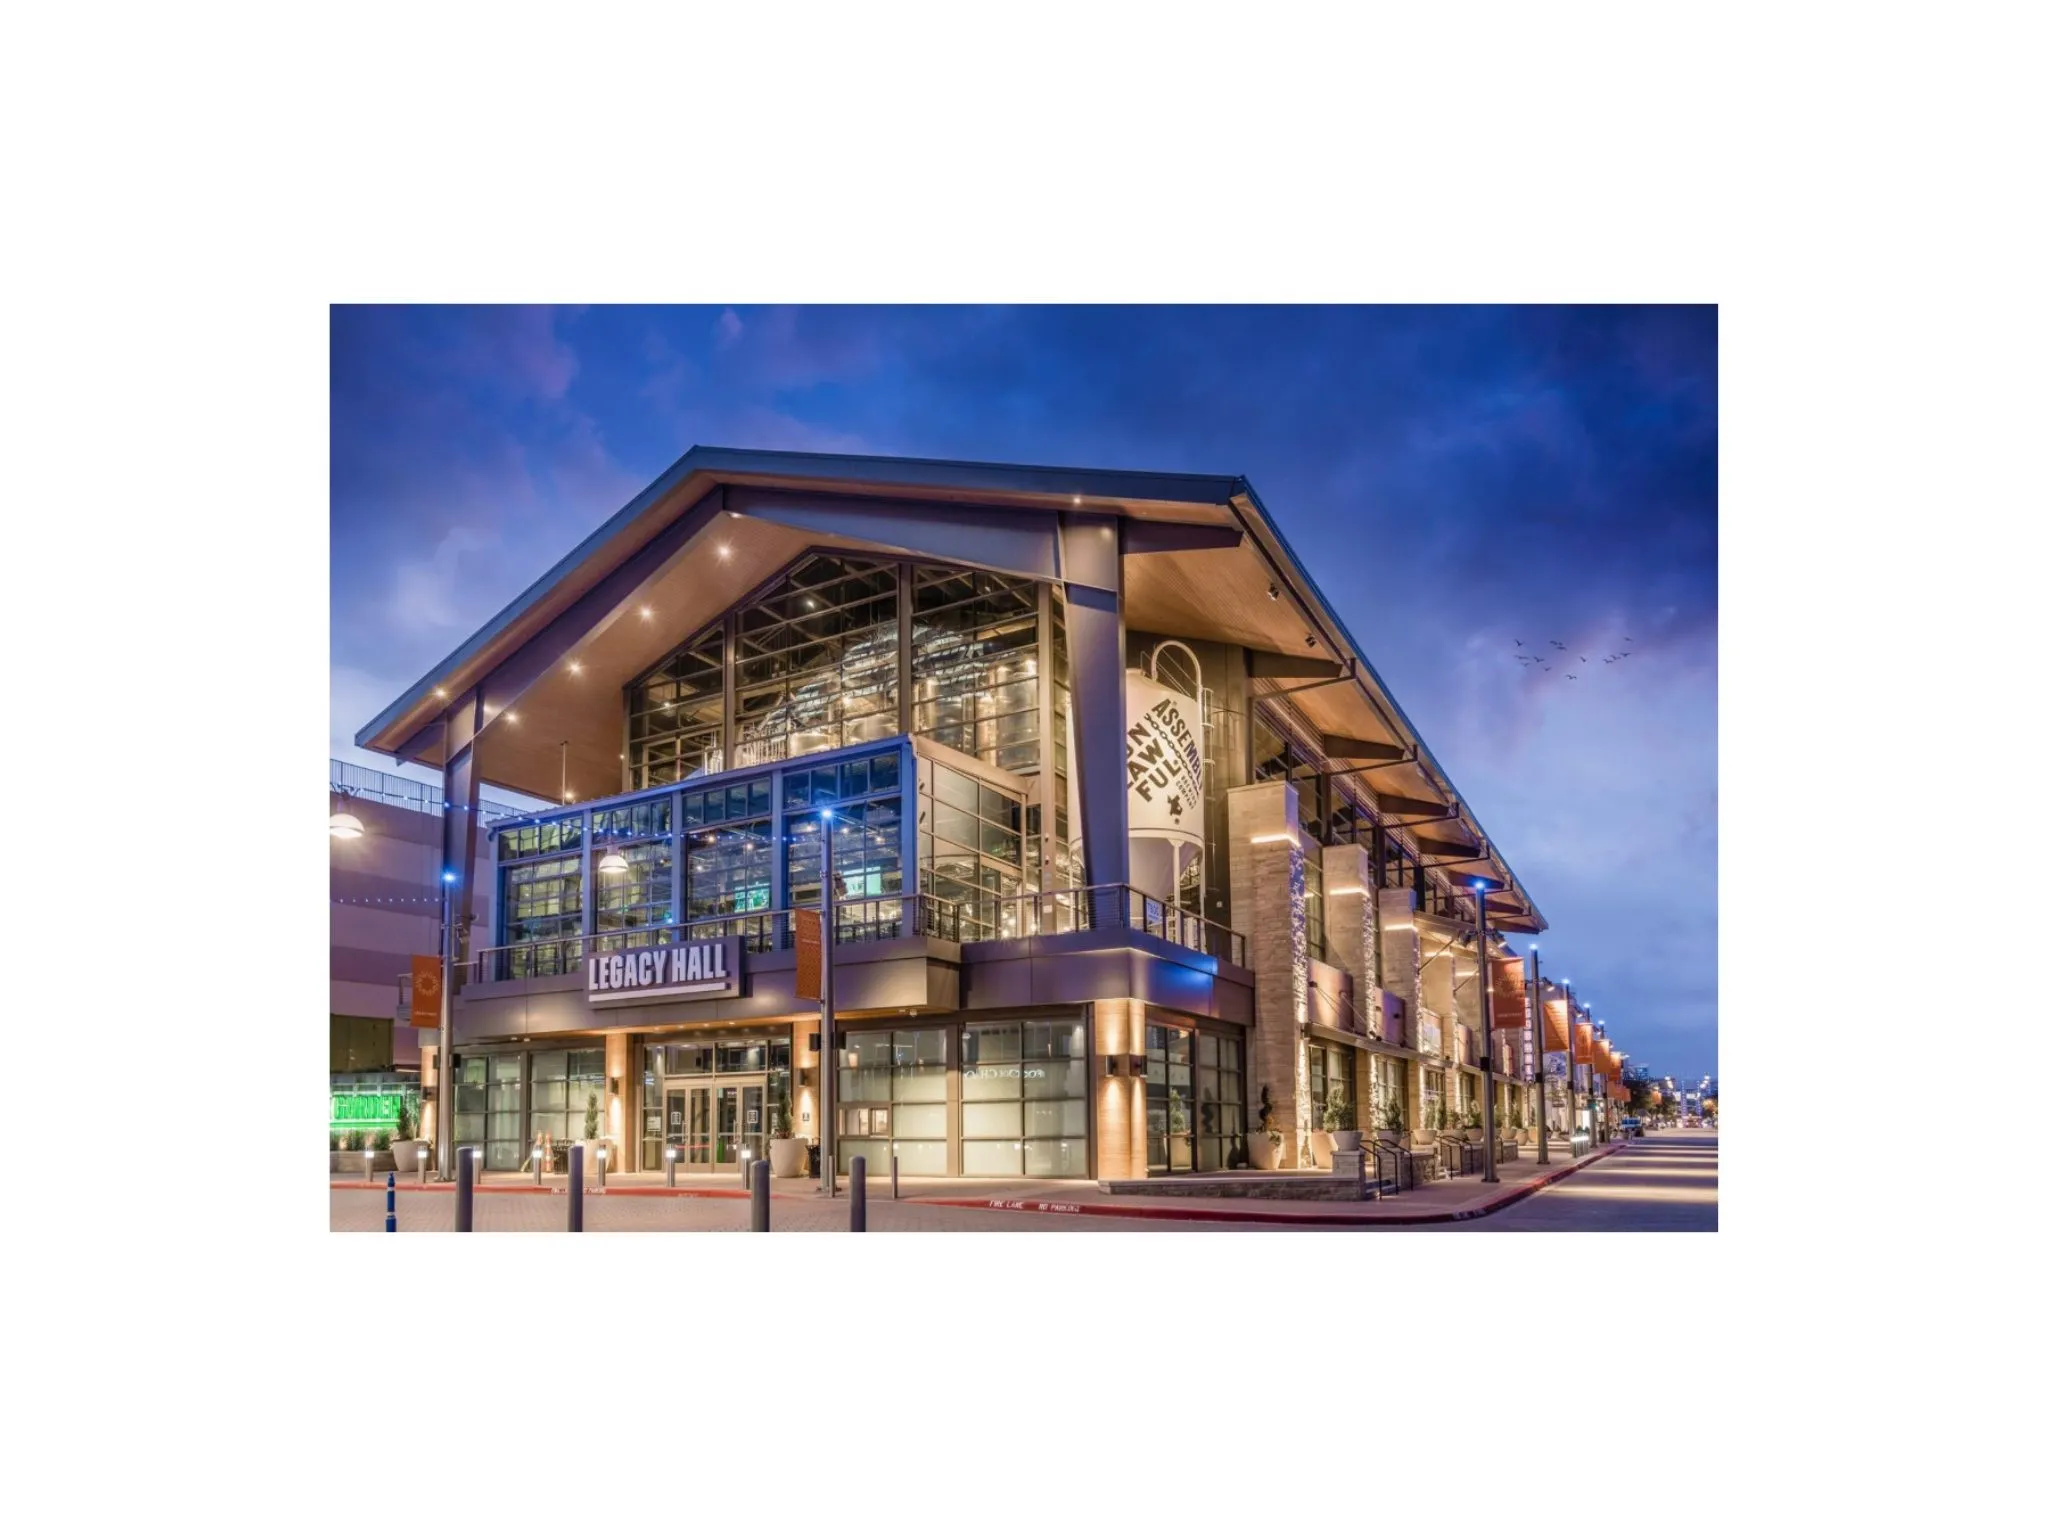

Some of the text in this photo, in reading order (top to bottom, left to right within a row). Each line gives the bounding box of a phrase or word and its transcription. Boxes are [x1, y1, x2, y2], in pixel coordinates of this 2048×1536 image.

[1135, 759, 1182, 803] FUL
[589, 943, 727, 991] LEGACY HALL
[1038, 1202, 1049, 1211] NO
